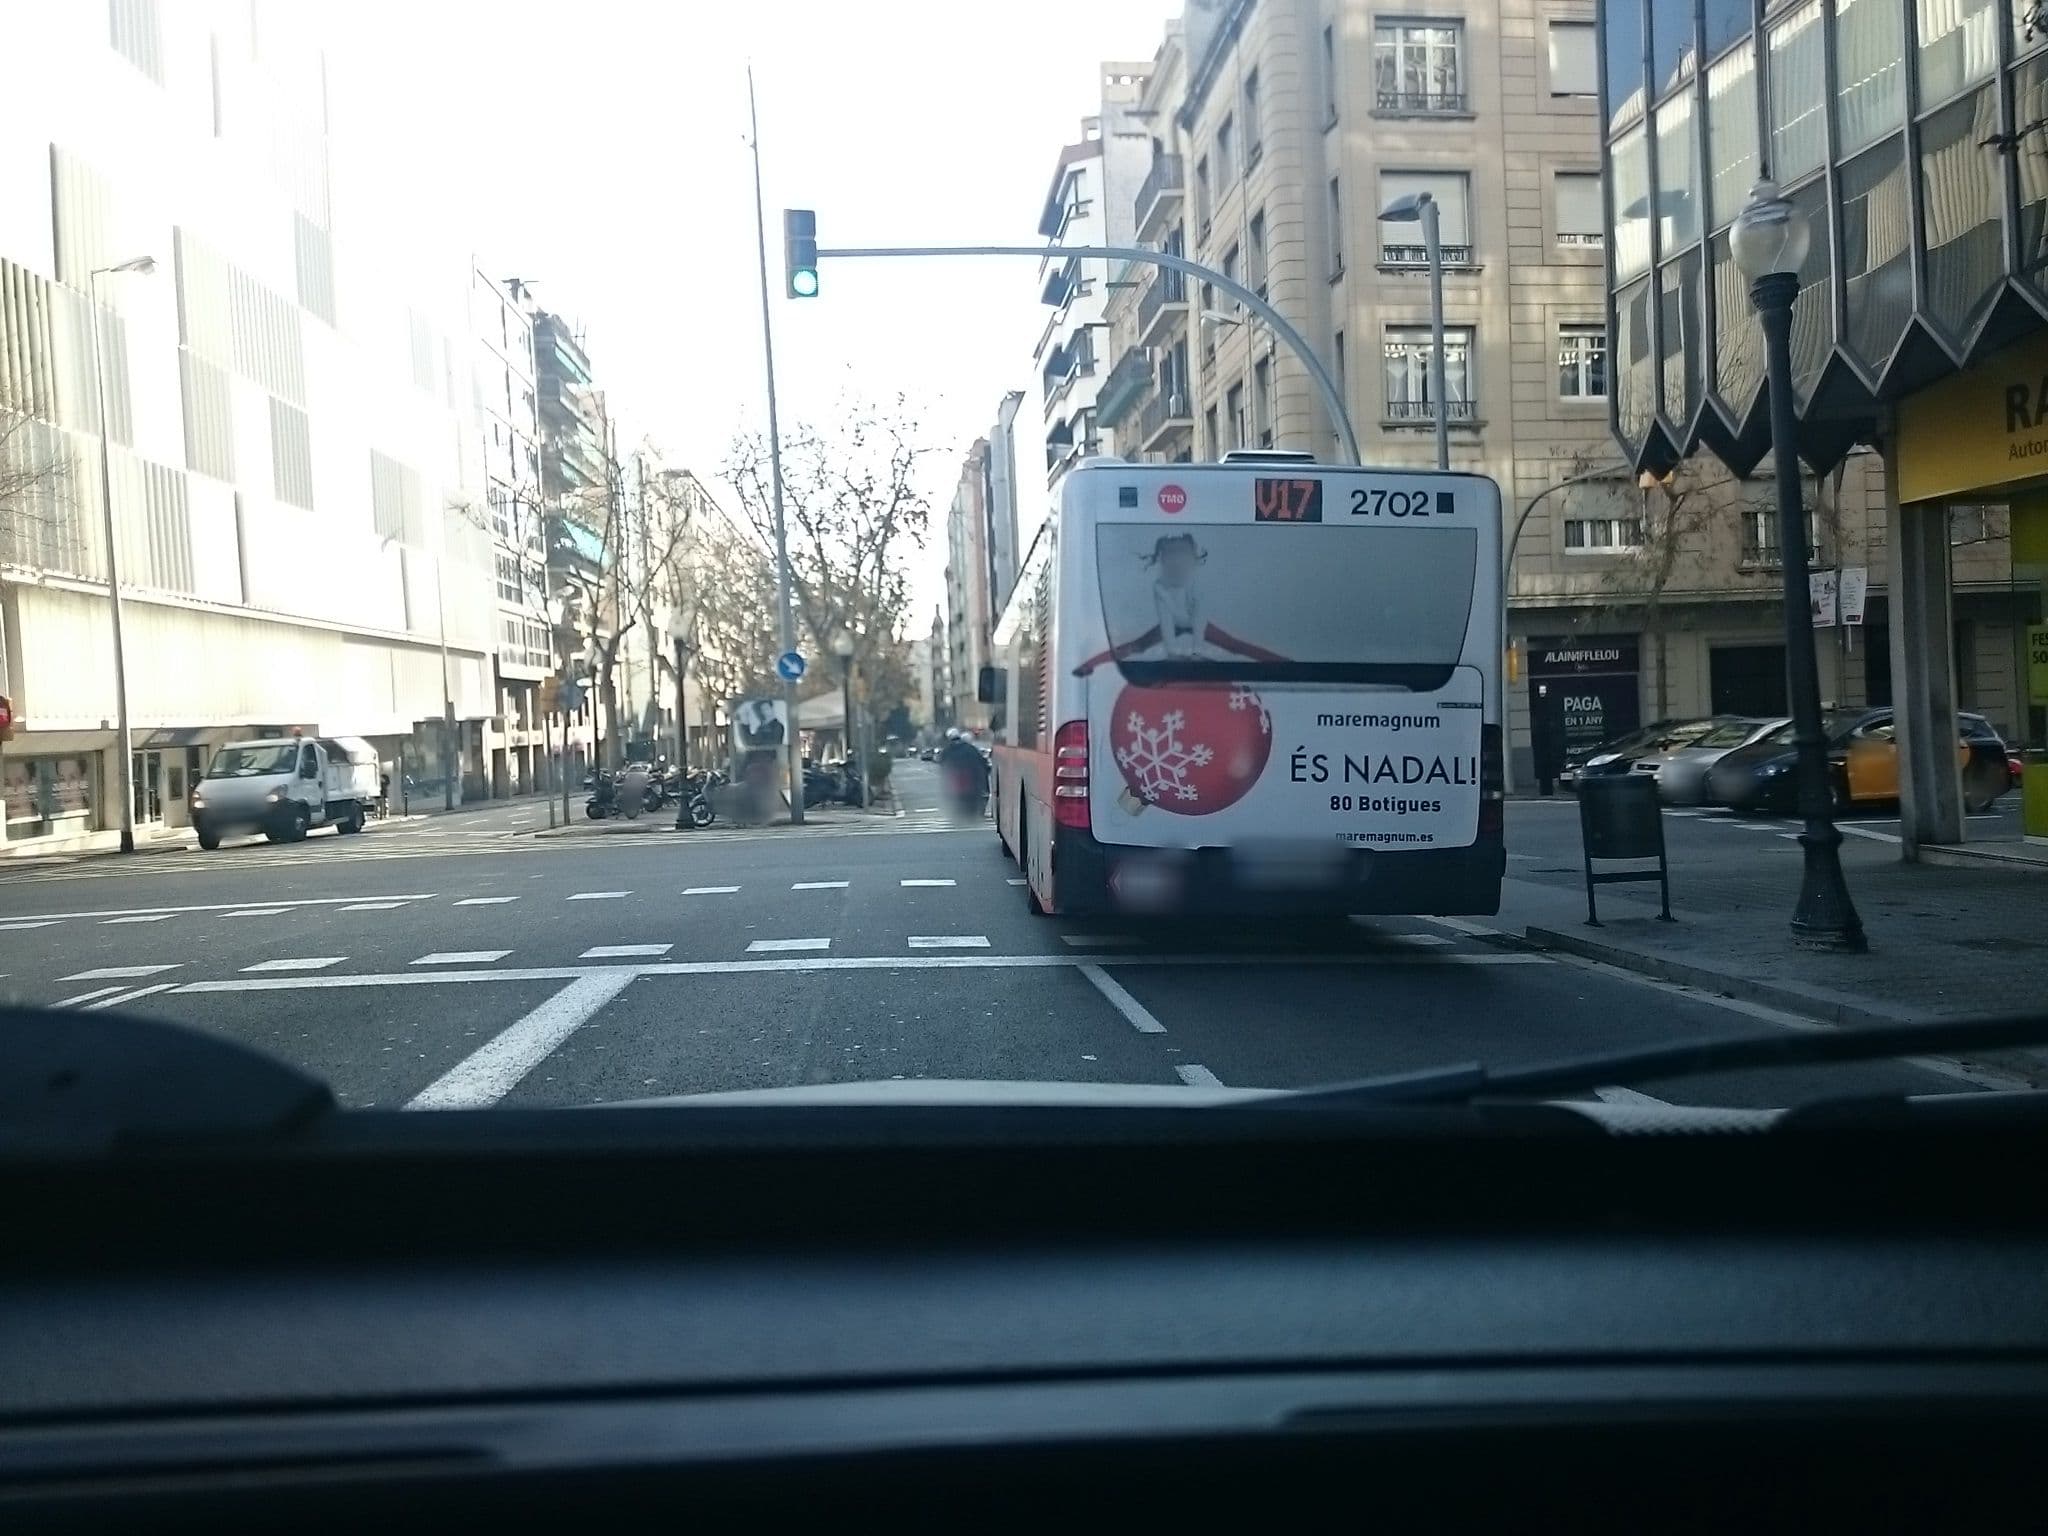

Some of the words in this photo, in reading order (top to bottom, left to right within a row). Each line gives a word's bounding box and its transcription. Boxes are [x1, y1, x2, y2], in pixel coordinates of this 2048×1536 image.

[1256, 480, 1314, 519] V17
[1351, 490, 1430, 517] 2702
[1564, 696, 1602, 712] PAGA
[1317, 714, 1440, 731] maremagnum
[1565, 717, 1577, 726] EN
[1585, 716, 1603, 725] ANY
[1291, 745, 1329, 783] ÉS
[1344, 754, 1477, 785] NADAL!
[1330, 796, 1352, 811] 80
[1359, 796, 1441, 814] Botigues
[1336, 832, 1434, 843] maremagnum.es
